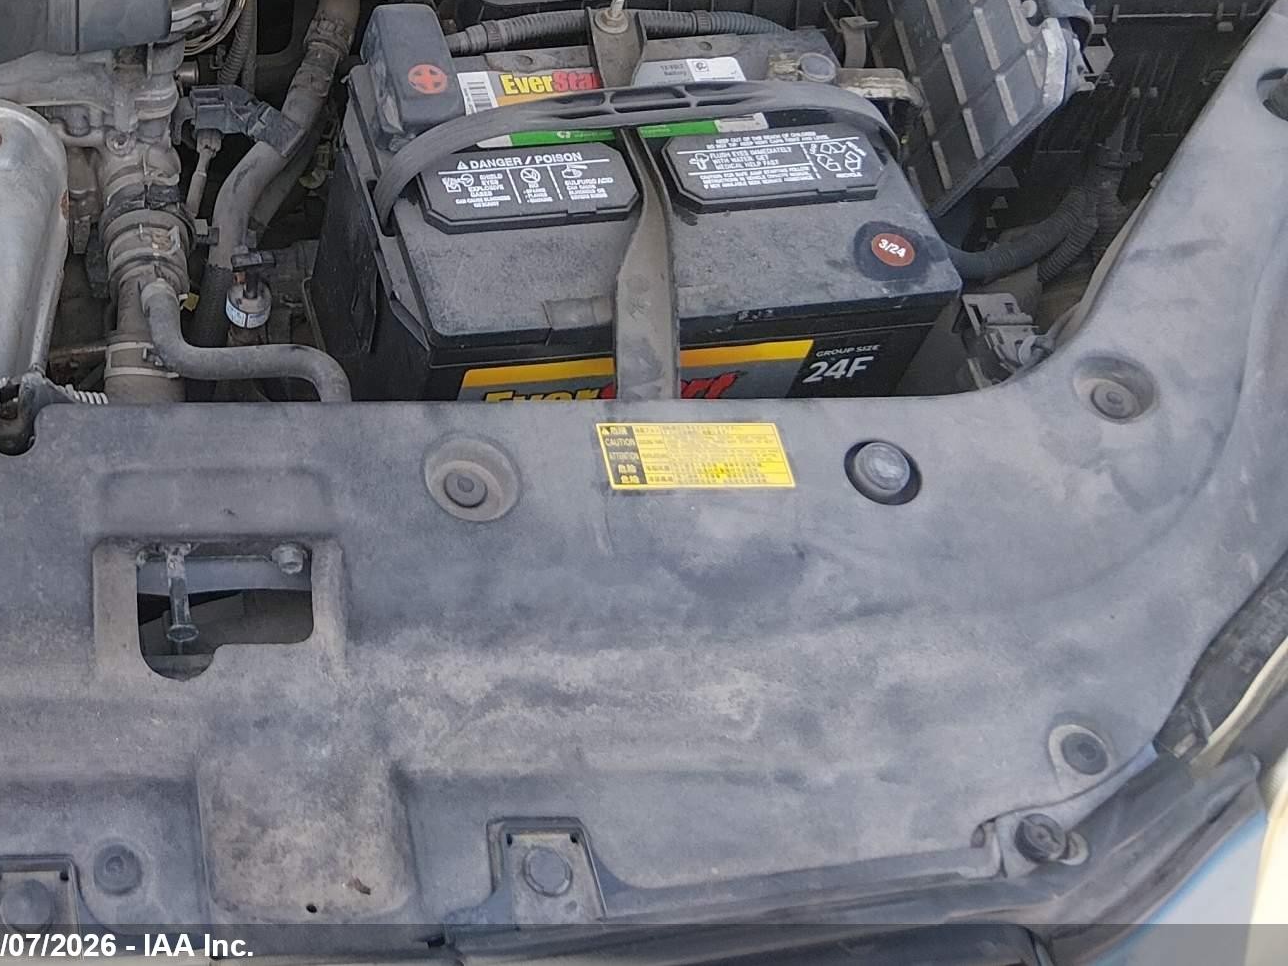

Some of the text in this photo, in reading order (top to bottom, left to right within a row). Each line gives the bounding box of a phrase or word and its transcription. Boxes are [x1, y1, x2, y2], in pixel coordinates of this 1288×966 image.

[469, 157, 522, 169] DANGER
[534, 152, 582, 164] POISON
[878, 238, 906, 258] 3/24
[816, 344, 881, 357] GROUP SIZE
[802, 356, 874, 384] 24F
[605, 437, 636, 447] CAUTION
